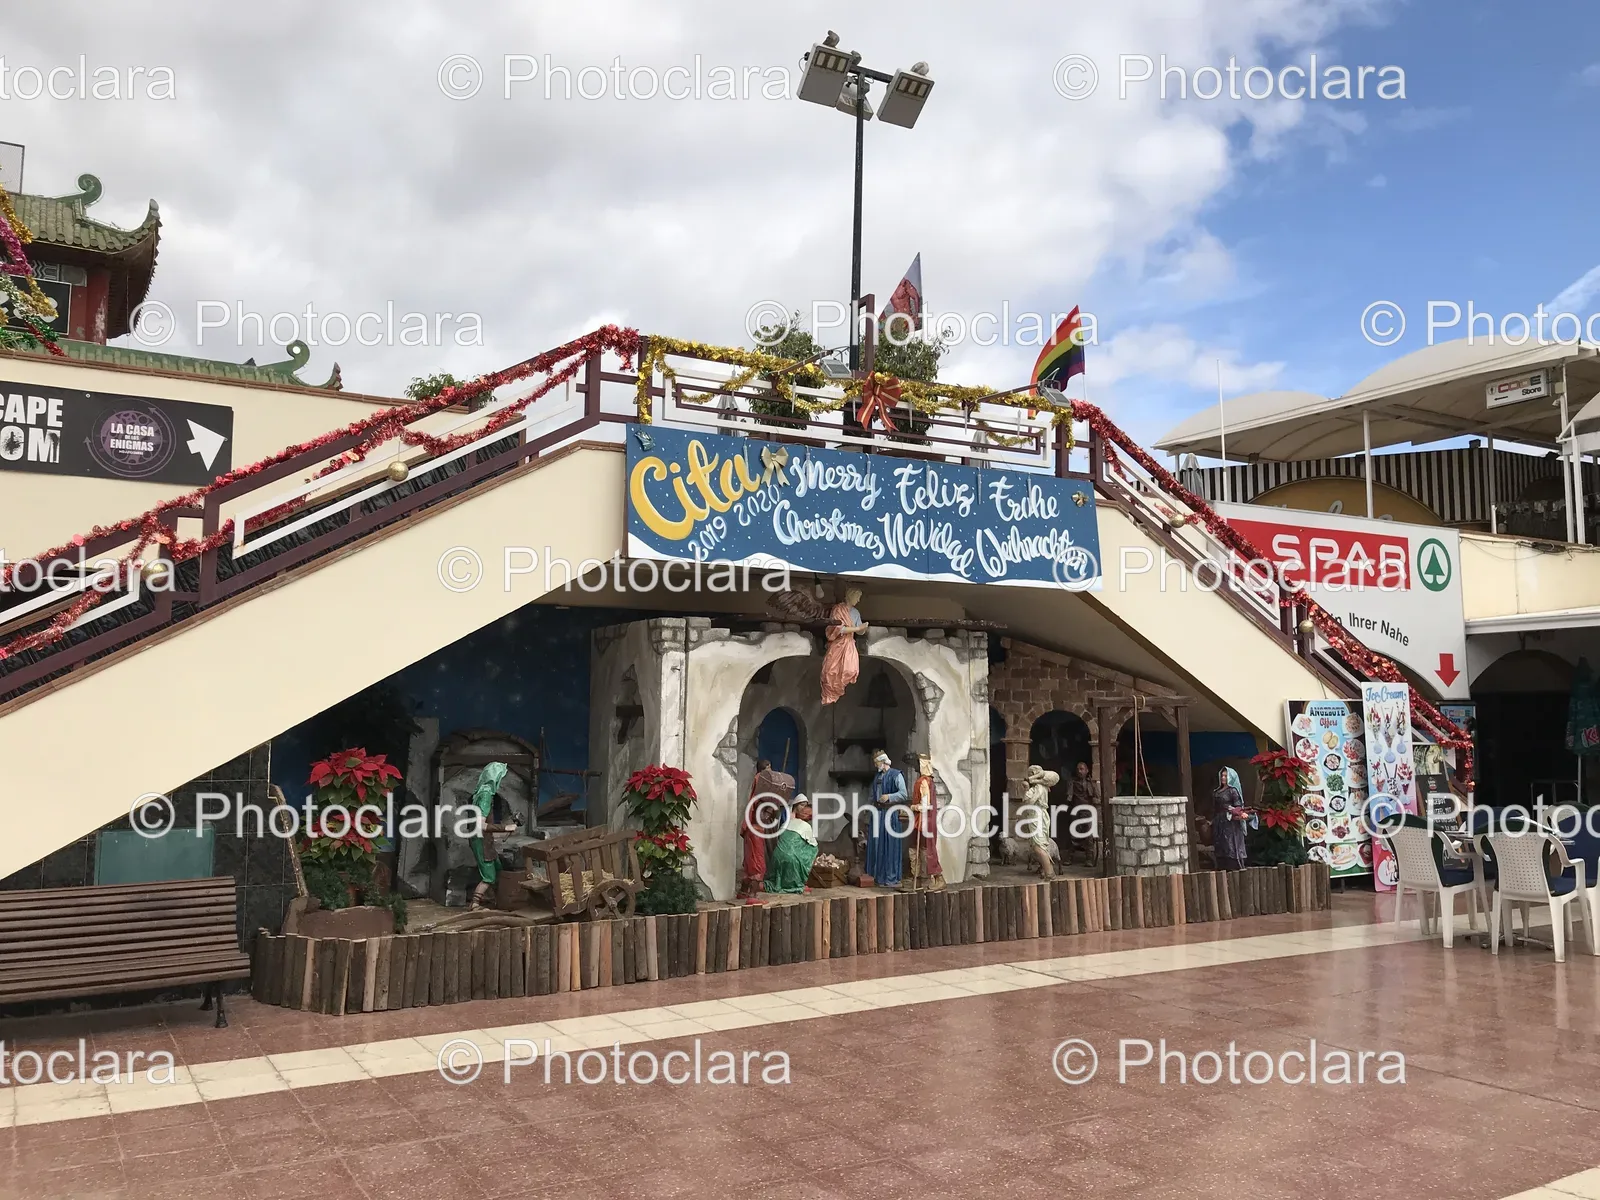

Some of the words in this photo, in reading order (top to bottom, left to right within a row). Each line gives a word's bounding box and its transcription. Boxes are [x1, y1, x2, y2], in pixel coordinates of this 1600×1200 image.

[1522, 386, 1541, 395] Store
[0, 393, 63, 428] APE
[110, 422, 124, 434] LA
[126, 424, 154, 437] CASA
[110, 438, 154, 452] ENIGMAS
[630, 439, 760, 541] Cita
[789, 456, 882, 511] Merry
[894, 463, 974, 517] Feliz
[687, 515, 727, 562] 2019
[733, 484, 780, 526] 2020
[773, 499, 885, 560] Christmas
[1272, 533, 1407, 580] SPAR
[1348, 612, 1377, 631] Ihrer
[1380, 620, 1409, 646] Nahe
[1365, 687, 1381, 703] Ice
[1379, 685, 1407, 703] Cream
